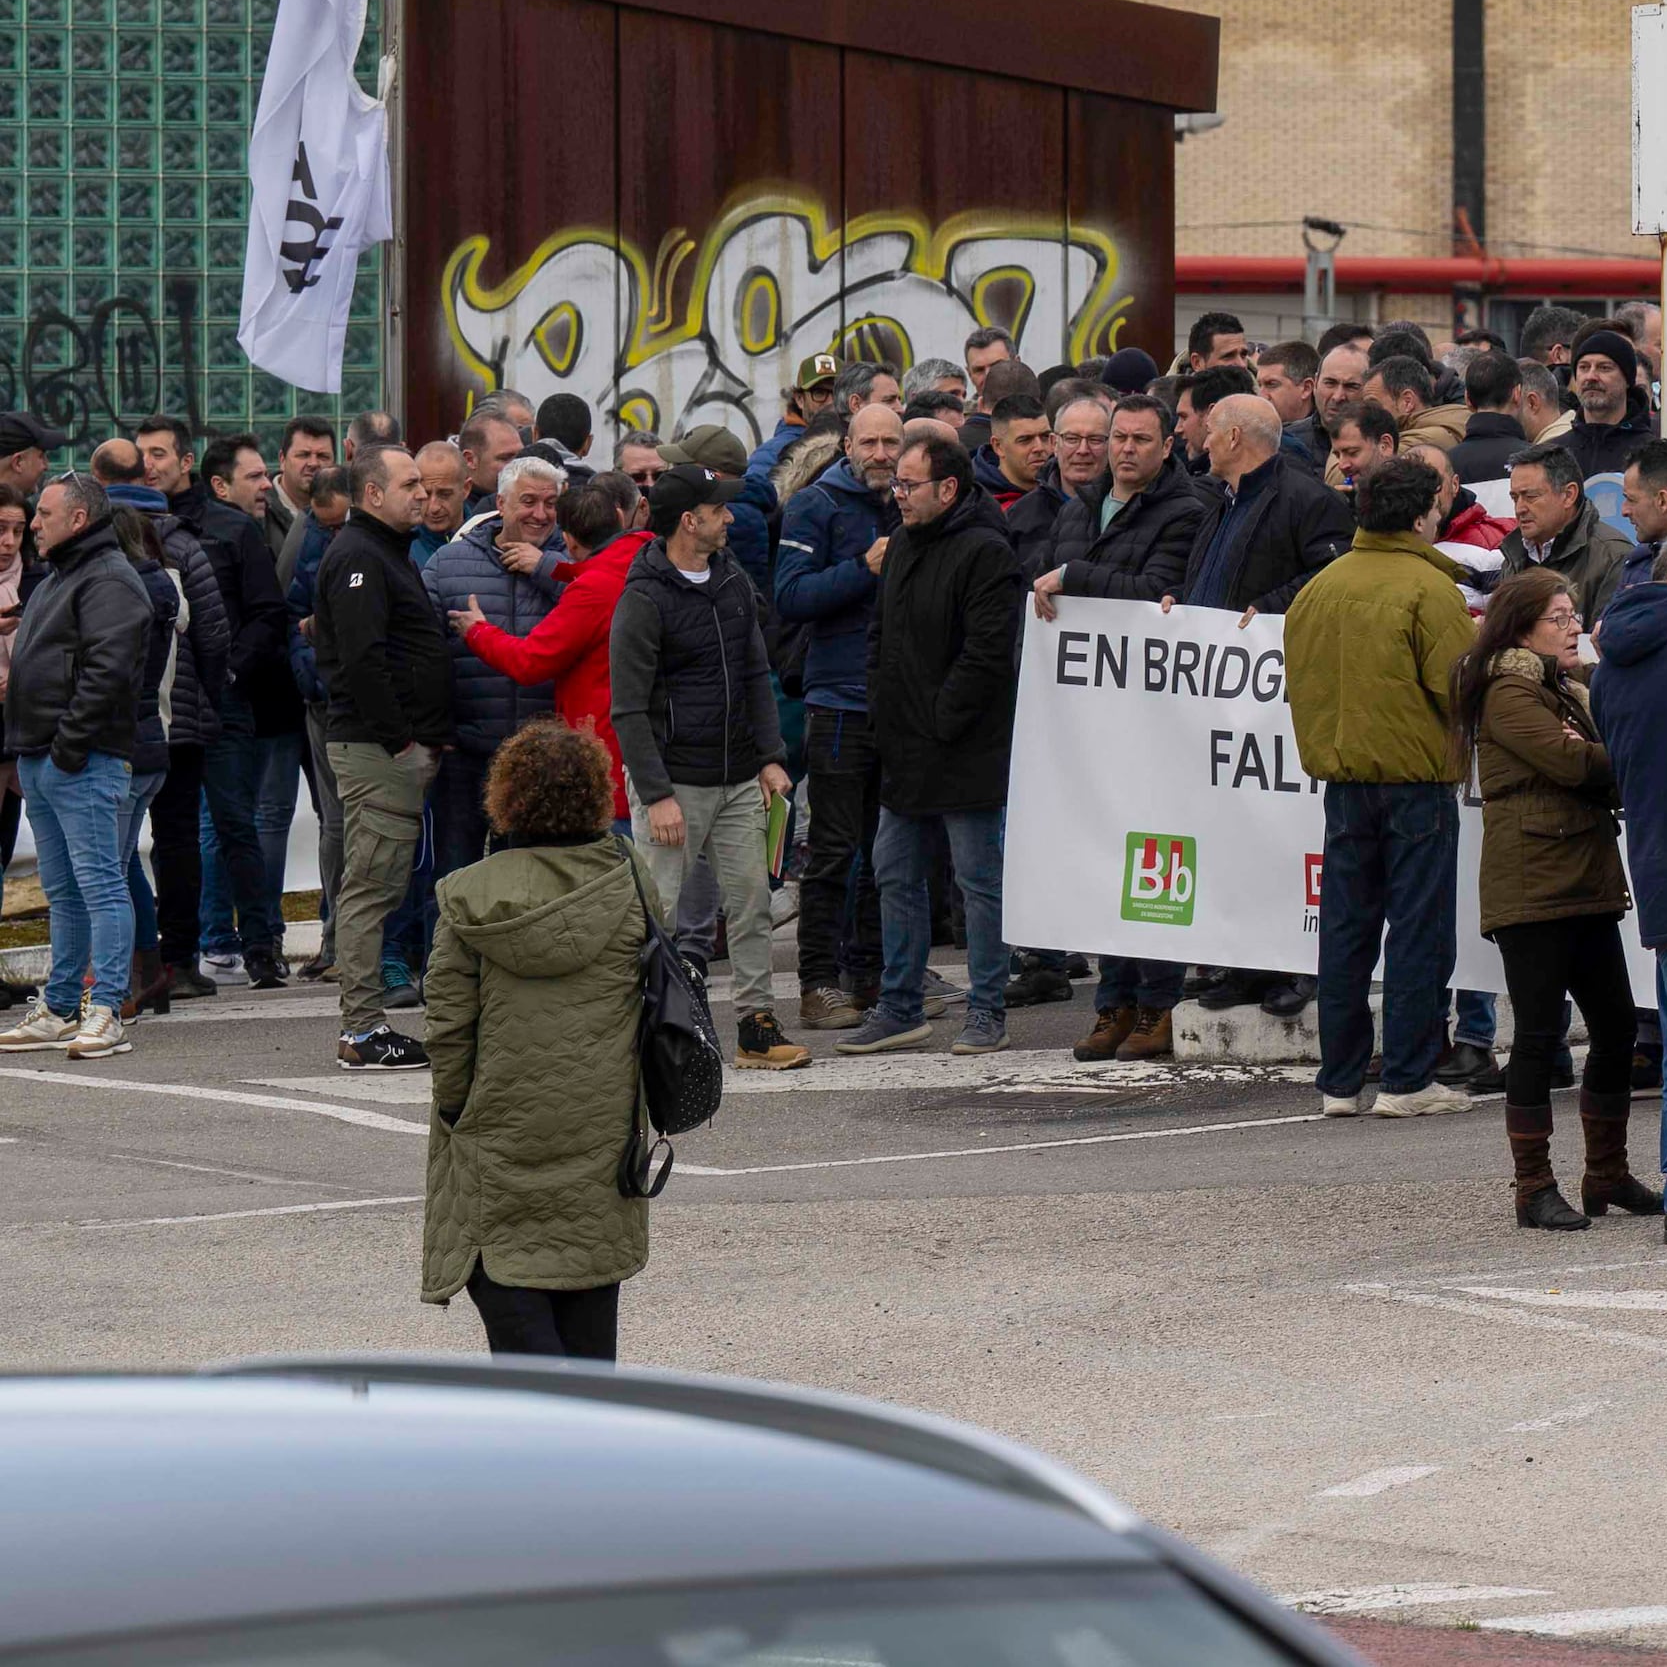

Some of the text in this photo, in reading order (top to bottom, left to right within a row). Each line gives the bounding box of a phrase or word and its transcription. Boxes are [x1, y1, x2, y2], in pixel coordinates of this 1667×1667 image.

[1056, 631, 1290, 704] EN BRIDG
[1210, 729, 1318, 794] FAL
